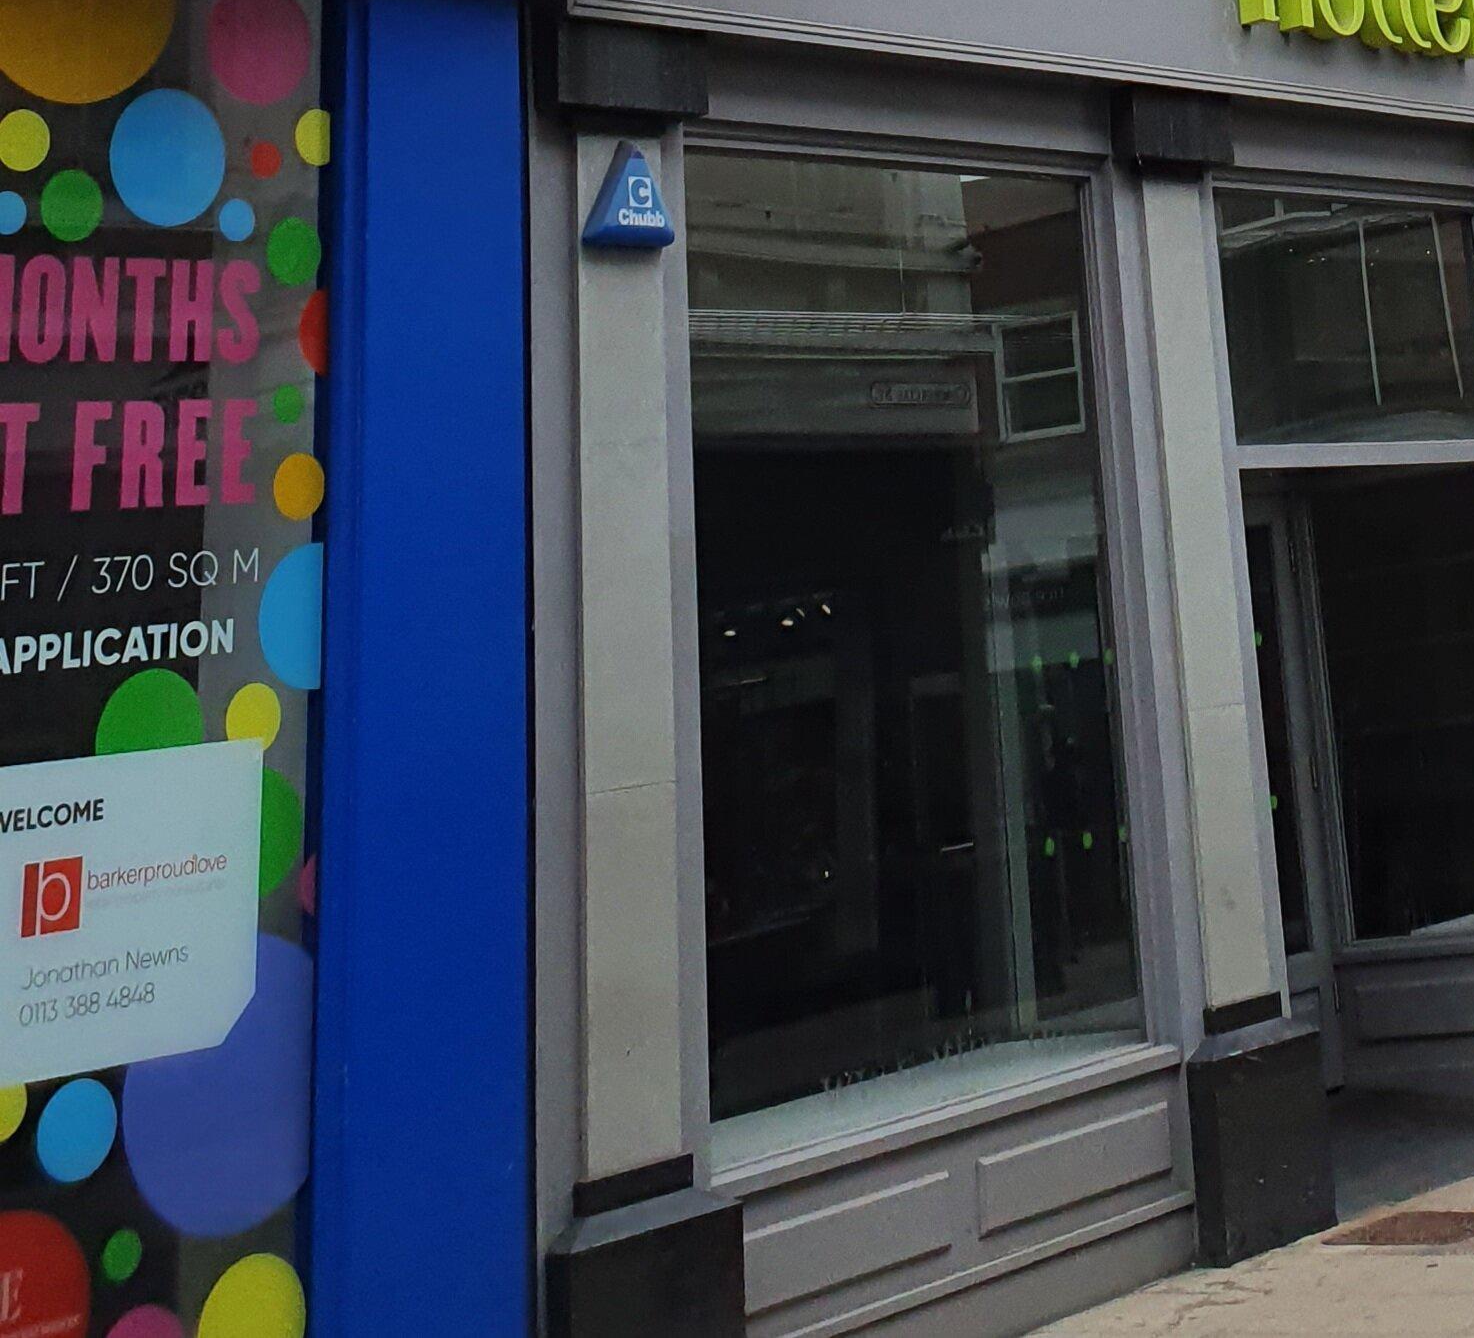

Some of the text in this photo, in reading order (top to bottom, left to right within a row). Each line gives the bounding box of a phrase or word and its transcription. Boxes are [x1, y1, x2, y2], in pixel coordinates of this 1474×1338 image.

[618, 208, 666, 228] Chubb
[70, 399, 258, 513] FREE
[0, 560, 46, 602] FT
[91, 553, 155, 595] 370
[167, 549, 219, 589] SQ
[233, 546, 260, 585] M
[86, 852, 228, 891] barkerproudlove
[21, 944, 189, 991] Jonathan Newns
[18, 981, 156, 1028] 0113 388 4848
